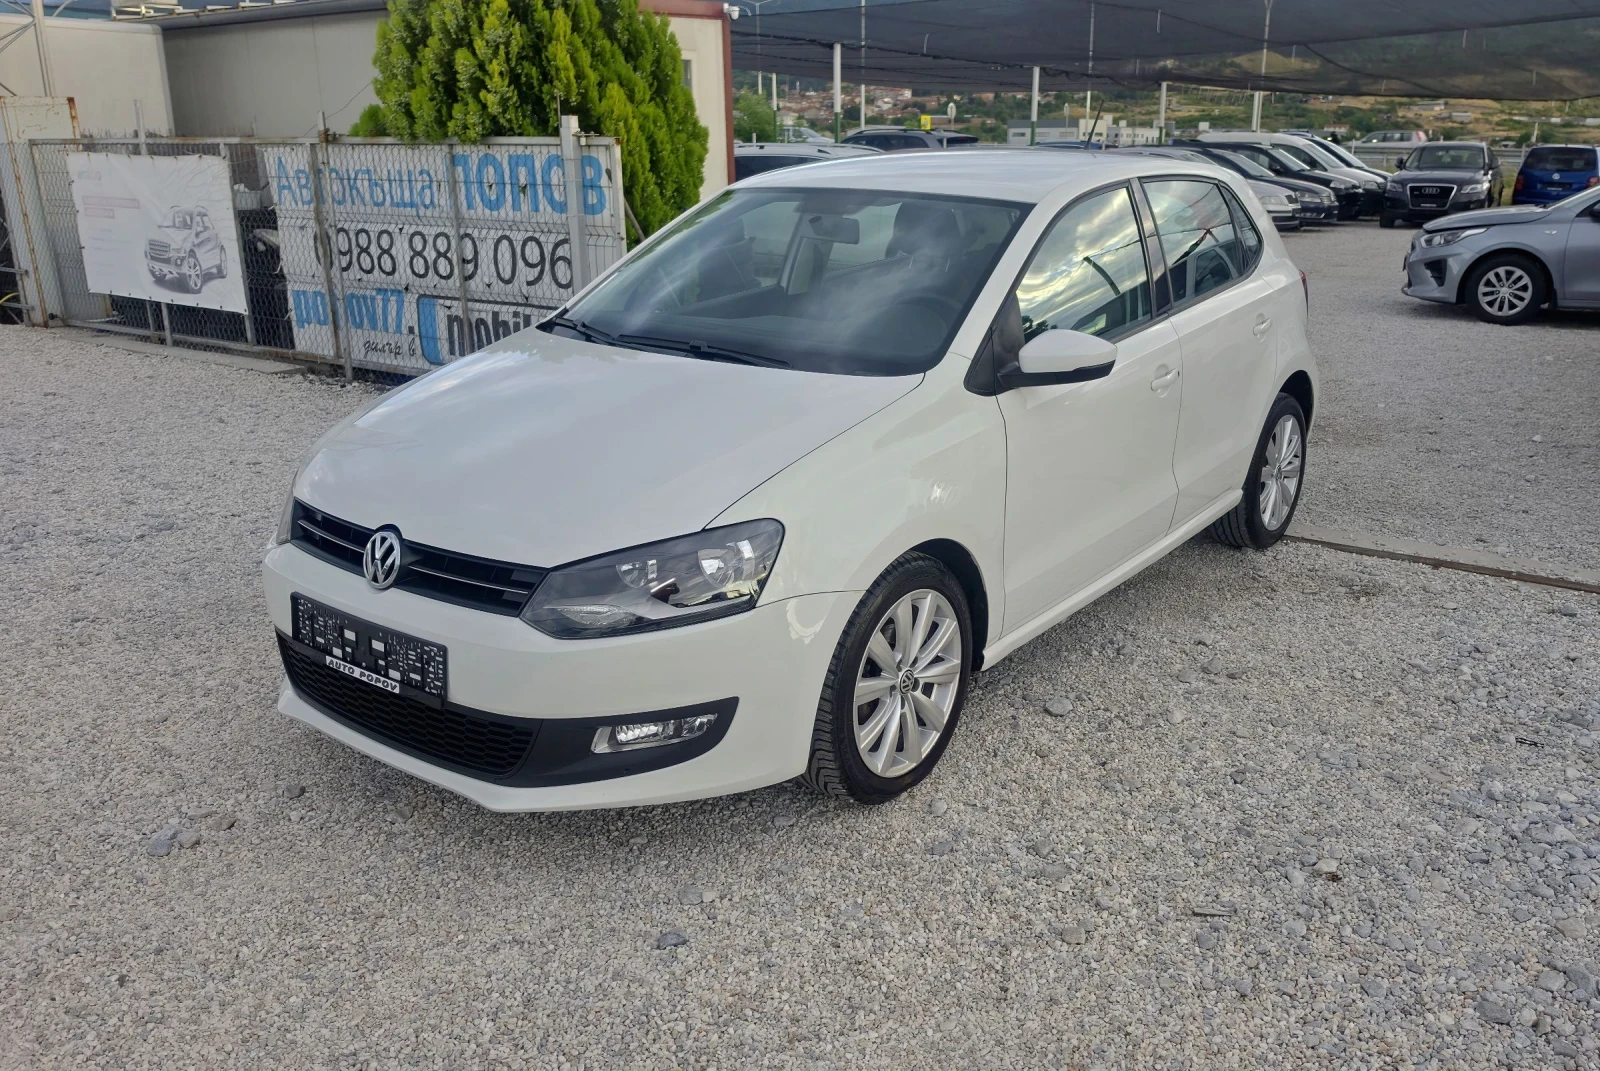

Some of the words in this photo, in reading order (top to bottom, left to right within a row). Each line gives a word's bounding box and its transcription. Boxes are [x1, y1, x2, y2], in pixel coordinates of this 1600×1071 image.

[276, 156, 436, 220] Автокъща
[313, 227, 397, 276] 0988
[409, 230, 479, 281] 889
[493, 234, 572, 289] 096
[328, 658, 354, 675] AUTO
[360, 670, 398, 691] POPOV
